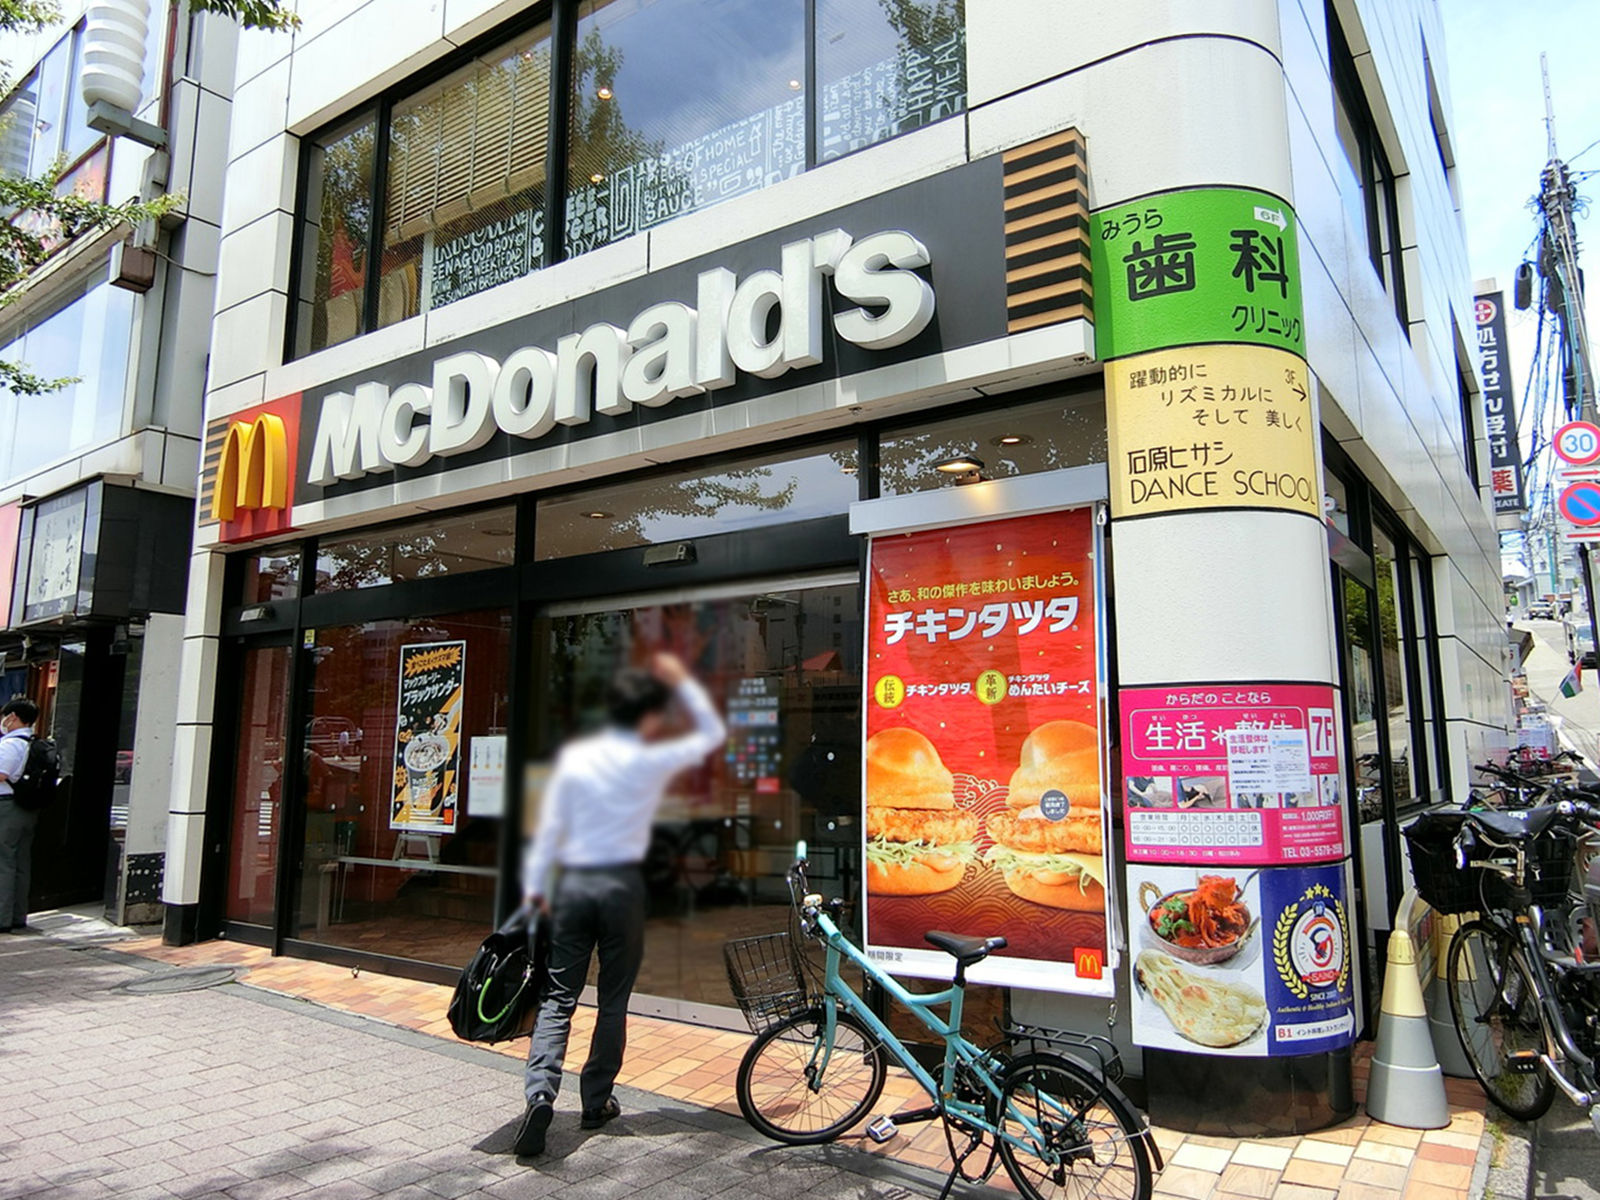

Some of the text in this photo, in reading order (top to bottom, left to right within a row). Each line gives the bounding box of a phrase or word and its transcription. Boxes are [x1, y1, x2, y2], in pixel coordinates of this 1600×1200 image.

[933, 32, 960, 100] MEAL
[705, 130, 746, 161] HOME
[700, 152, 753, 183] SPECIAL
[1101, 208, 1165, 241] みうら
[462, 242, 493, 267] GOOD
[494, 233, 515, 256] BOY
[1122, 228, 1290, 302] 歯科
[1231, 305, 1301, 343] クリニック
[307, 227, 937, 487] McDonald's
[1129, 363, 1208, 390] 躍動的に
[1161, 384, 1274, 407] リズミカルに
[1192, 408, 1304, 433] そして 美しく
[1127, 441, 1234, 475] 石原ヒサシ
[1565, 433, 1594, 453] 30
[1131, 470, 1316, 506] DANCE SCHOOL
[887, 571, 1080, 604] さあ、和の傑作を味わいましょう。
[884, 596, 1079, 645] チキンタツタ
[883, 680, 895, 704] 伝統
[906, 682, 971, 697] チキンタツタ
[985, 674, 997, 700] 革新
[1008, 673, 1050, 683] チキンタツタ
[1008, 680, 1091, 697] めんたいチーズ
[1166, 691, 1272, 706] からだのことなら
[1311, 715, 1333, 751] 7F
[1282, 847, 1298, 859] TEL
[1278, 1028, 1293, 1039] B1
